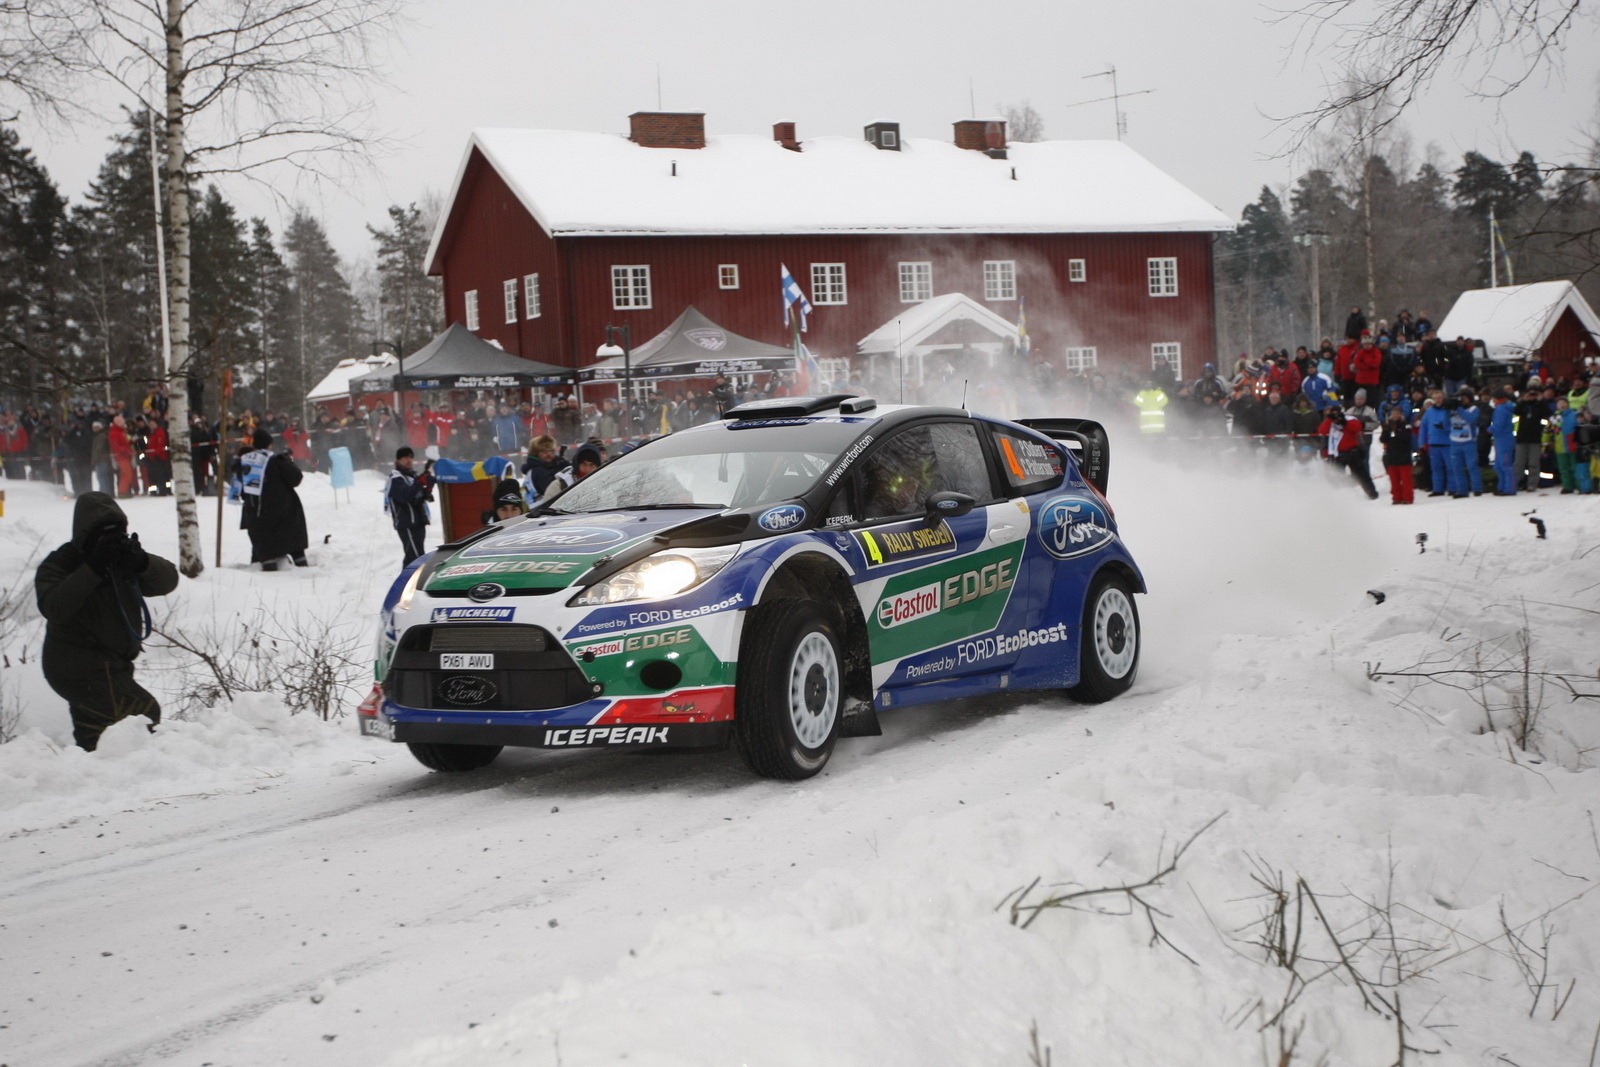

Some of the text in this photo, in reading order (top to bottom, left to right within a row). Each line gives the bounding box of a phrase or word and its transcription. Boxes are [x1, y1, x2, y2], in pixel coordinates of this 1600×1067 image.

[825, 434, 875, 487] www.wrcford.com
[1001, 438, 1025, 480] 4
[765, 509, 800, 530] Ford
[826, 515, 854, 526] ICEPEAK
[1053, 504, 1107, 551] Ford
[497, 529, 600, 547] Ford
[860, 531, 882, 564] 4
[881, 530, 915, 554] RALLY
[488, 561, 582, 574] EDGE
[578, 597, 608, 605] PIAA
[894, 557, 1014, 622] Castrol EDGE
[449, 608, 511, 618] MICHELIN
[578, 592, 744, 633] Powered by FORD EcoBoost
[584, 628, 692, 655] Castrol EDGE
[905, 621, 1068, 680] Powered by FORD EcoBoost
[442, 655, 493, 668] PX61 AWU
[543, 726, 670, 746] ICEPEAK
